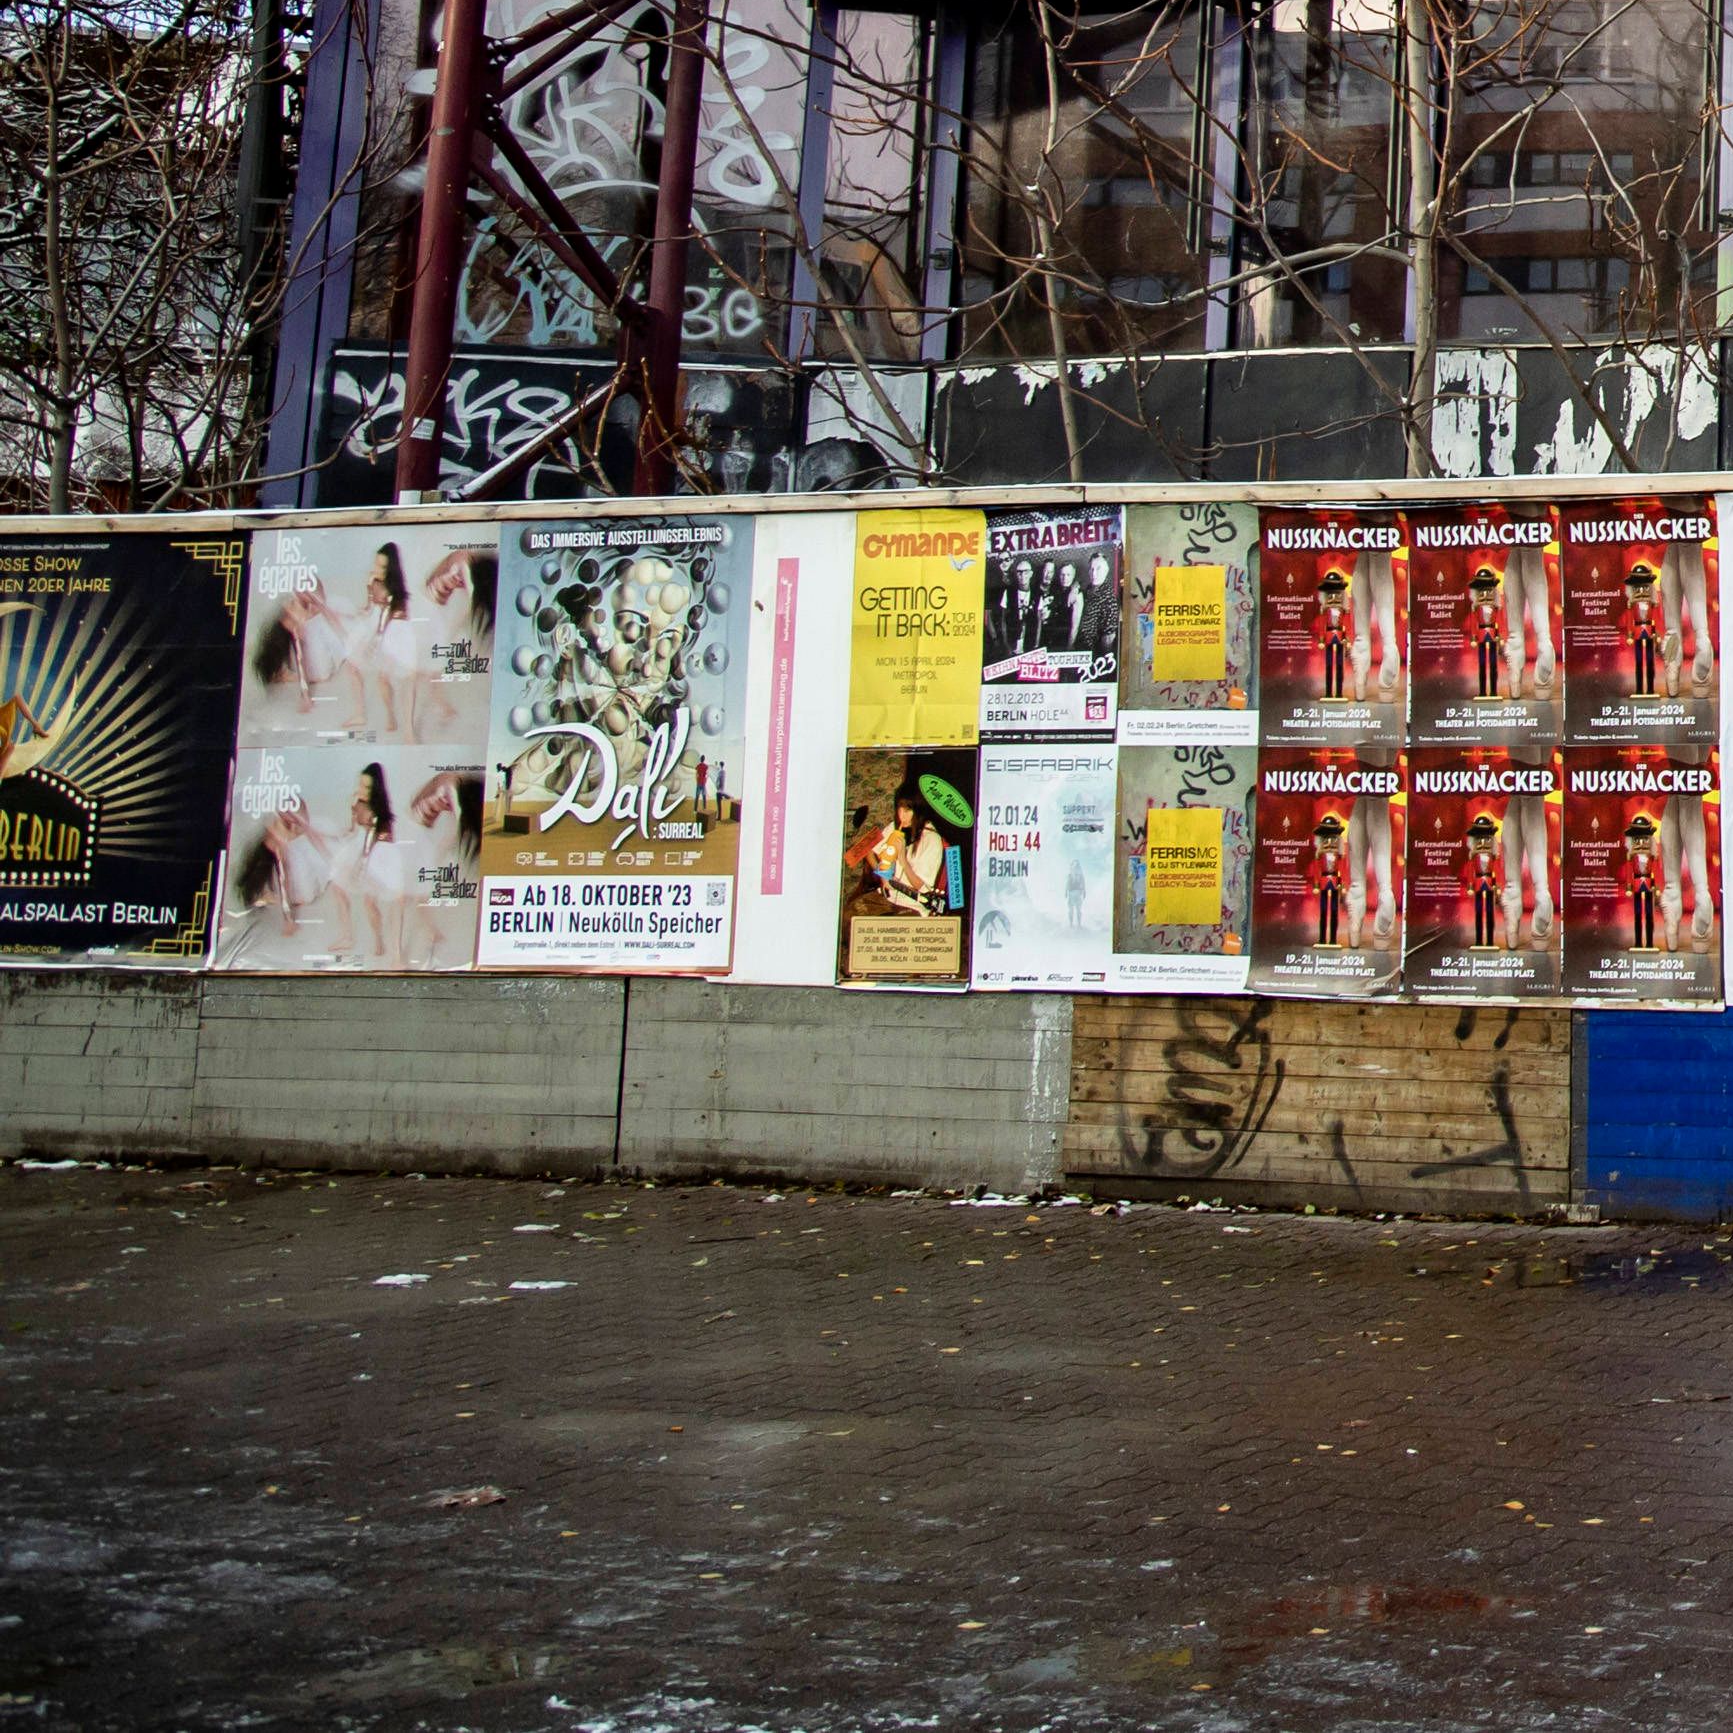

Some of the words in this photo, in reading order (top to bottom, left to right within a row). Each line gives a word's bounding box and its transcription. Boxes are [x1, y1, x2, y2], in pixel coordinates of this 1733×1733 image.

[1416, 522, 1553, 547] NUSSKNACKER
[1570, 518, 1711, 543] NUSSKNACKER
[531, 534, 550, 550] DAS
[552, 530, 605, 548] IMMERSIVE
[607, 527, 722, 546] AUSSTELLUNGSERLEBNIS
[1267, 528, 1400, 549] NUSSKNACKER
[276, 529, 301, 565] les
[34, 555, 81, 572] SHOW
[259, 557, 318, 600] égarés
[28, 577, 65, 593] 20ER
[67, 576, 111, 596] JAHRE
[860, 586, 948, 611] GETTING
[1267, 595, 1314, 603] International
[1417, 593, 1464, 601] International
[1571, 589, 1620, 598] International
[1428, 602, 1454, 610] Festival
[1581, 599, 1610, 607] Festival
[1280, 612, 1300, 620] Ballet
[1430, 611, 1452, 619] Ballet
[1584, 608, 1607, 616] Ballet
[877, 614, 892, 637] IT
[896, 613, 950, 637] BACK:
[1078, 652, 1116, 683] 2023
[987, 693, 1044, 704] 28.12.2023
[987, 710, 1027, 721] BERLIN
[1293, 708, 1320, 718] 19.-21.
[1349, 708, 1371, 718] 2024
[1446, 707, 1474, 717] 19.-21.
[1503, 706, 1527, 716] 2024
[1602, 706, 1631, 716] 19.-21.
[1661, 705, 1684, 715] 2024
[774, 657, 788, 794] www.kulturplakatierung.de
[1362, 721, 1382, 729] PLATZ
[1518, 717, 1538, 726] PLATZ
[1675, 716, 1696, 725] PLATZ
[261, 748, 284, 783] les
[986, 758, 1113, 772] EISFABRIK
[1265, 770, 1399, 793] NUSSKNACKER
[1415, 770, 1554, 792] NUSSKNACKER
[1571, 770, 1712, 792] NUSSKNACKER
[242, 776, 300, 819] égarés
[988, 805, 1038, 825] 12.01.24
[658, 823, 705, 840] SURREAL
[1024, 831, 1040, 851] 44
[1263, 838, 1309, 846] International
[1414, 840, 1462, 848] International
[1571, 840, 1620, 848] International
[1272, 847, 1299, 855] Festival
[1424, 849, 1452, 857] Festival
[1581, 850, 1609, 858] Festival
[1275, 856, 1296, 864] Ballet
[1427, 858, 1449, 866] Ballet
[1584, 858, 1606, 866] Ballet
[523, 884, 545, 906] Ab
[552, 884, 576, 906] 18.
[582, 884, 662, 906] OKTOBER
[112, 902, 177, 924] BERLIN
[490, 912, 554, 933] BERLIN
[569, 911, 643, 933] Neukölln
[649, 911, 723, 940] Speicher
[1286, 954, 1313, 964] 19.-21.
[1342, 955, 1365, 966] 2024
[1442, 957, 1470, 967] 19.-21.
[1500, 957, 1524, 967] 2024
[1601, 958, 1629, 969] 19.-21.
[1660, 959, 1684, 970] 2024
[1355, 968, 1376, 977] PLATZ
[1514, 969, 1535, 978] PLATZ
[1674, 971, 1696, 980] PLATZ
